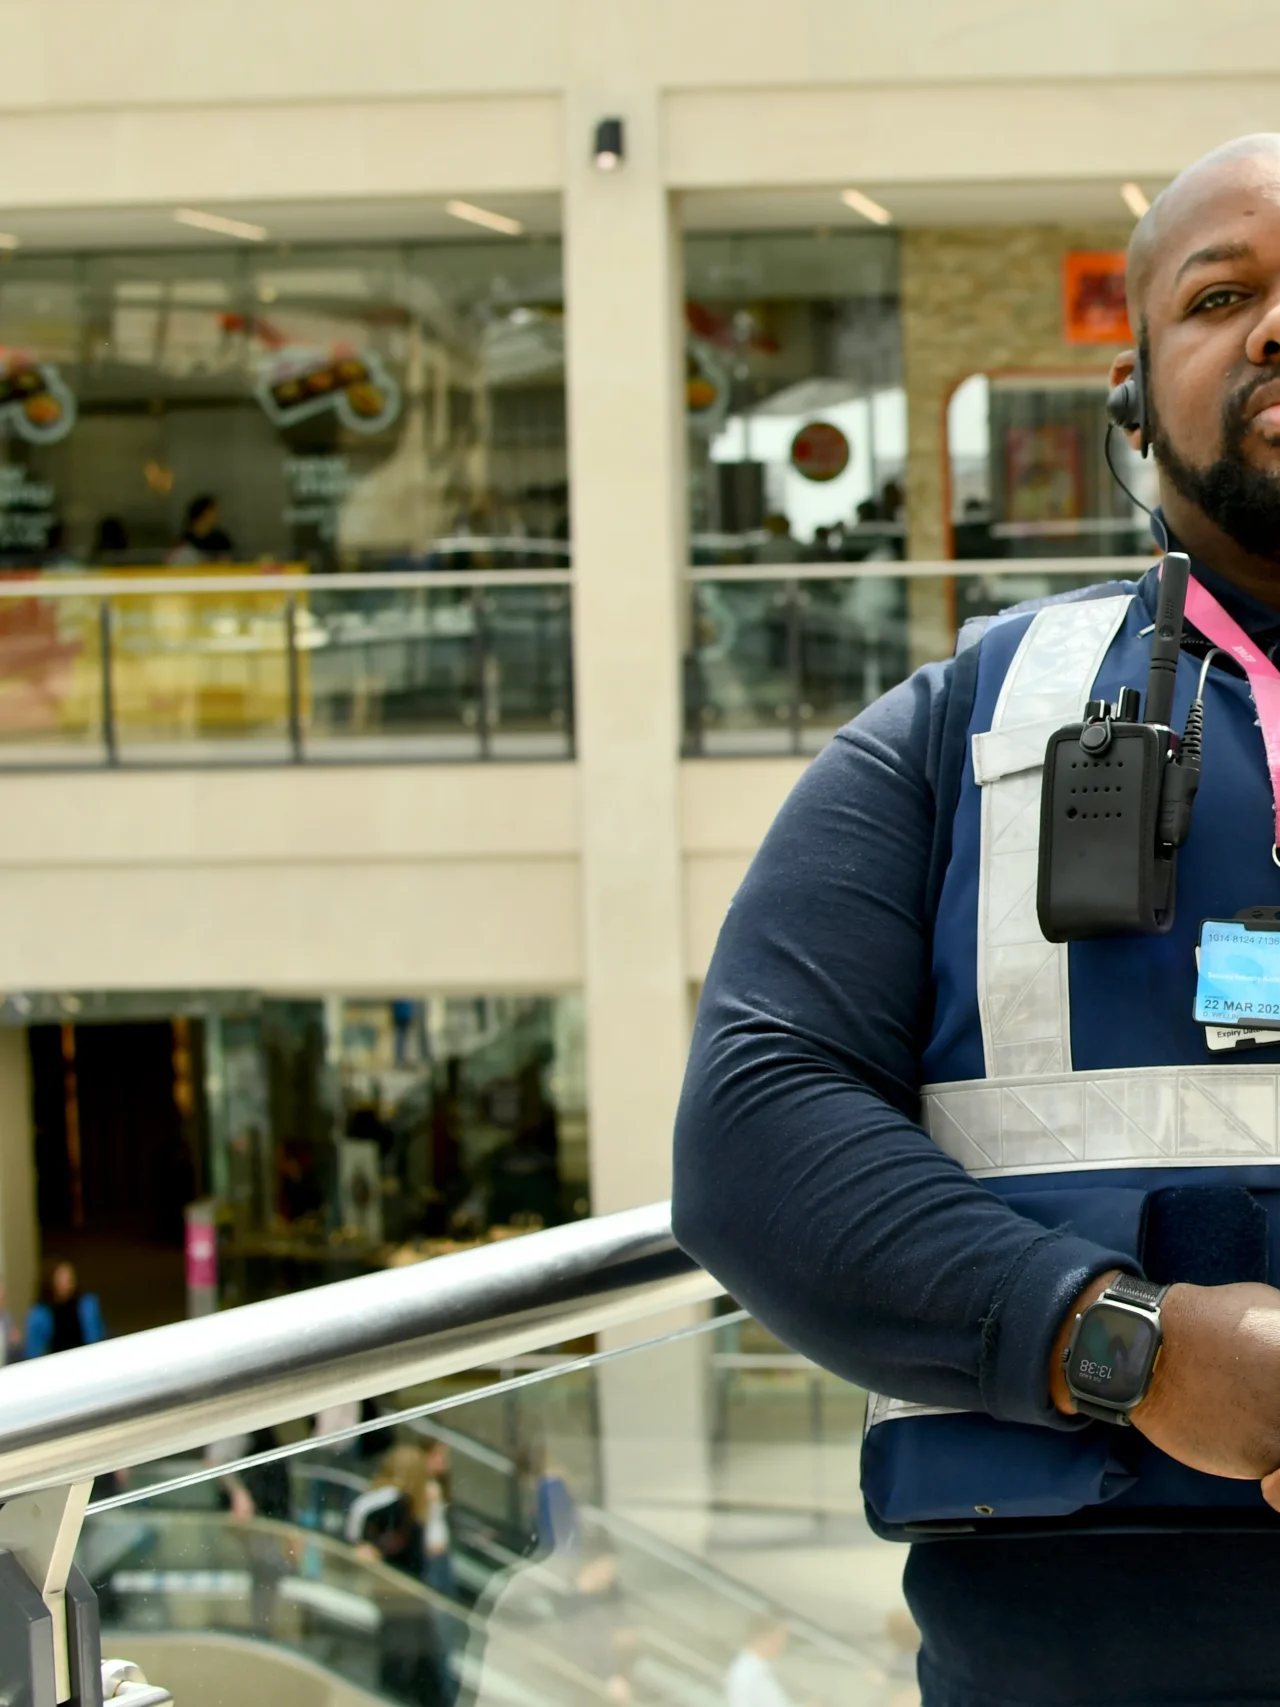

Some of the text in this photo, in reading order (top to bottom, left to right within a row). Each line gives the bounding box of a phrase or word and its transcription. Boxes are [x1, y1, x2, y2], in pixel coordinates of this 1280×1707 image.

[1208, 934, 1230, 942] 1014
[1232, 936, 1255, 944] 8124
[1257, 937, 1280, 945] 7136
[1204, 999, 1219, 1010] 22
[1223, 1001, 1254, 1012] MAR
[1216, 1028, 1241, 1038] Expiry
[1080, 1360, 1112, 1379] 13:38
